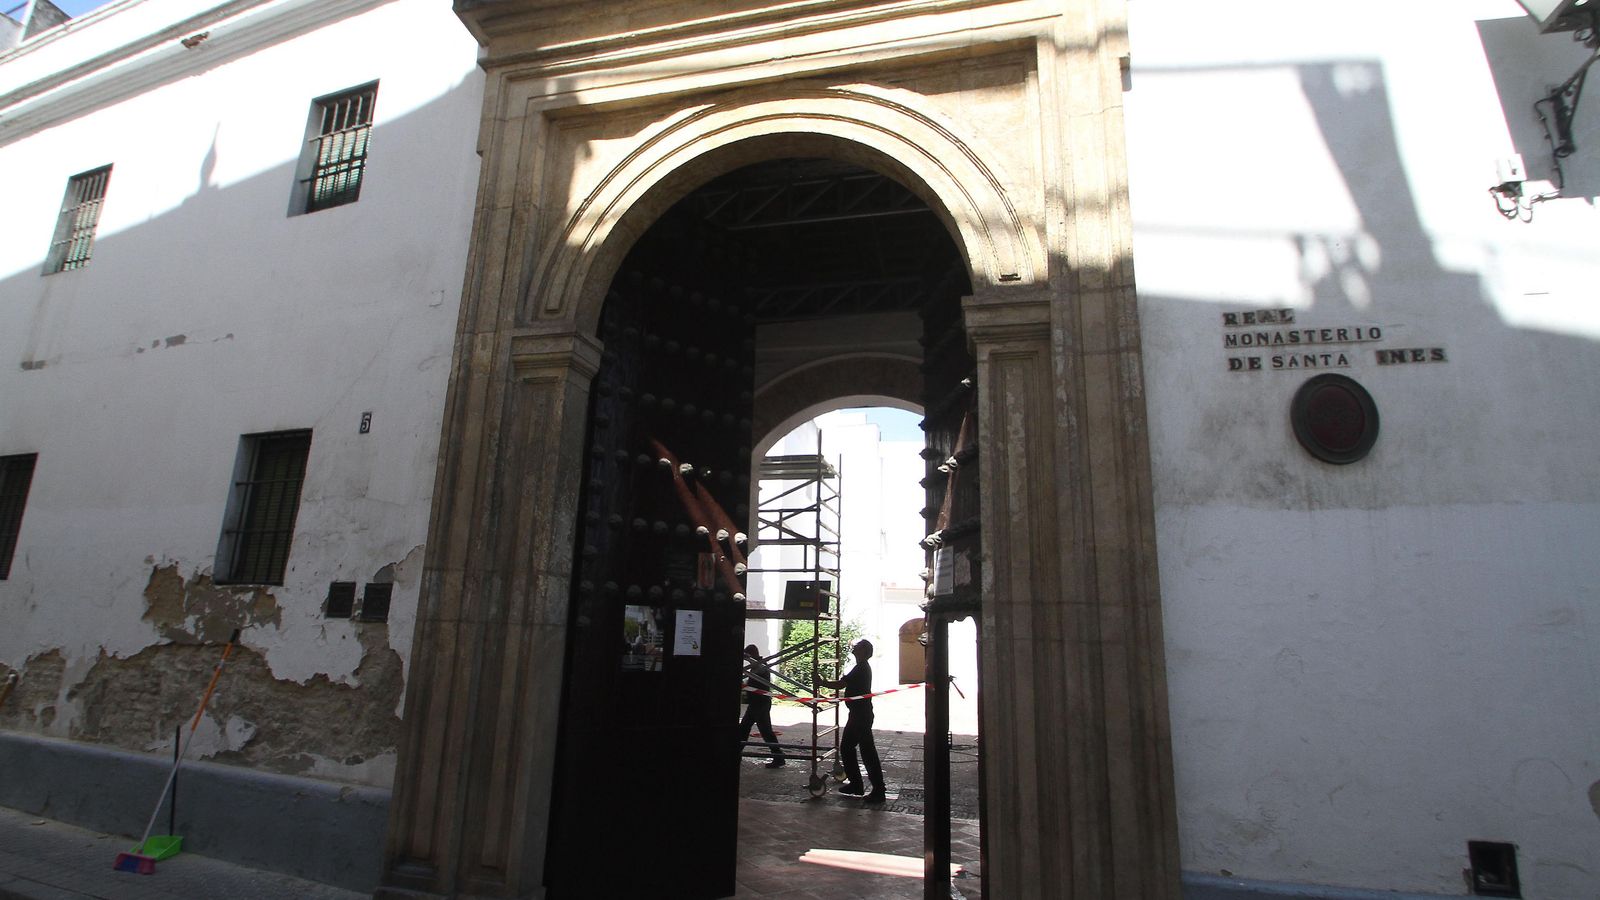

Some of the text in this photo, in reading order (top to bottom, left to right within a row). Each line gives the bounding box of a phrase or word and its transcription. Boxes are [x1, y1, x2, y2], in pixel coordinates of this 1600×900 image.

[1223, 309, 1294, 325] REAL
[1225, 327, 1382, 346] MONASTERIO
[1228, 356, 1262, 371] DE
[1272, 353, 1349, 368] SANTA
[361, 414, 371, 432] 5
